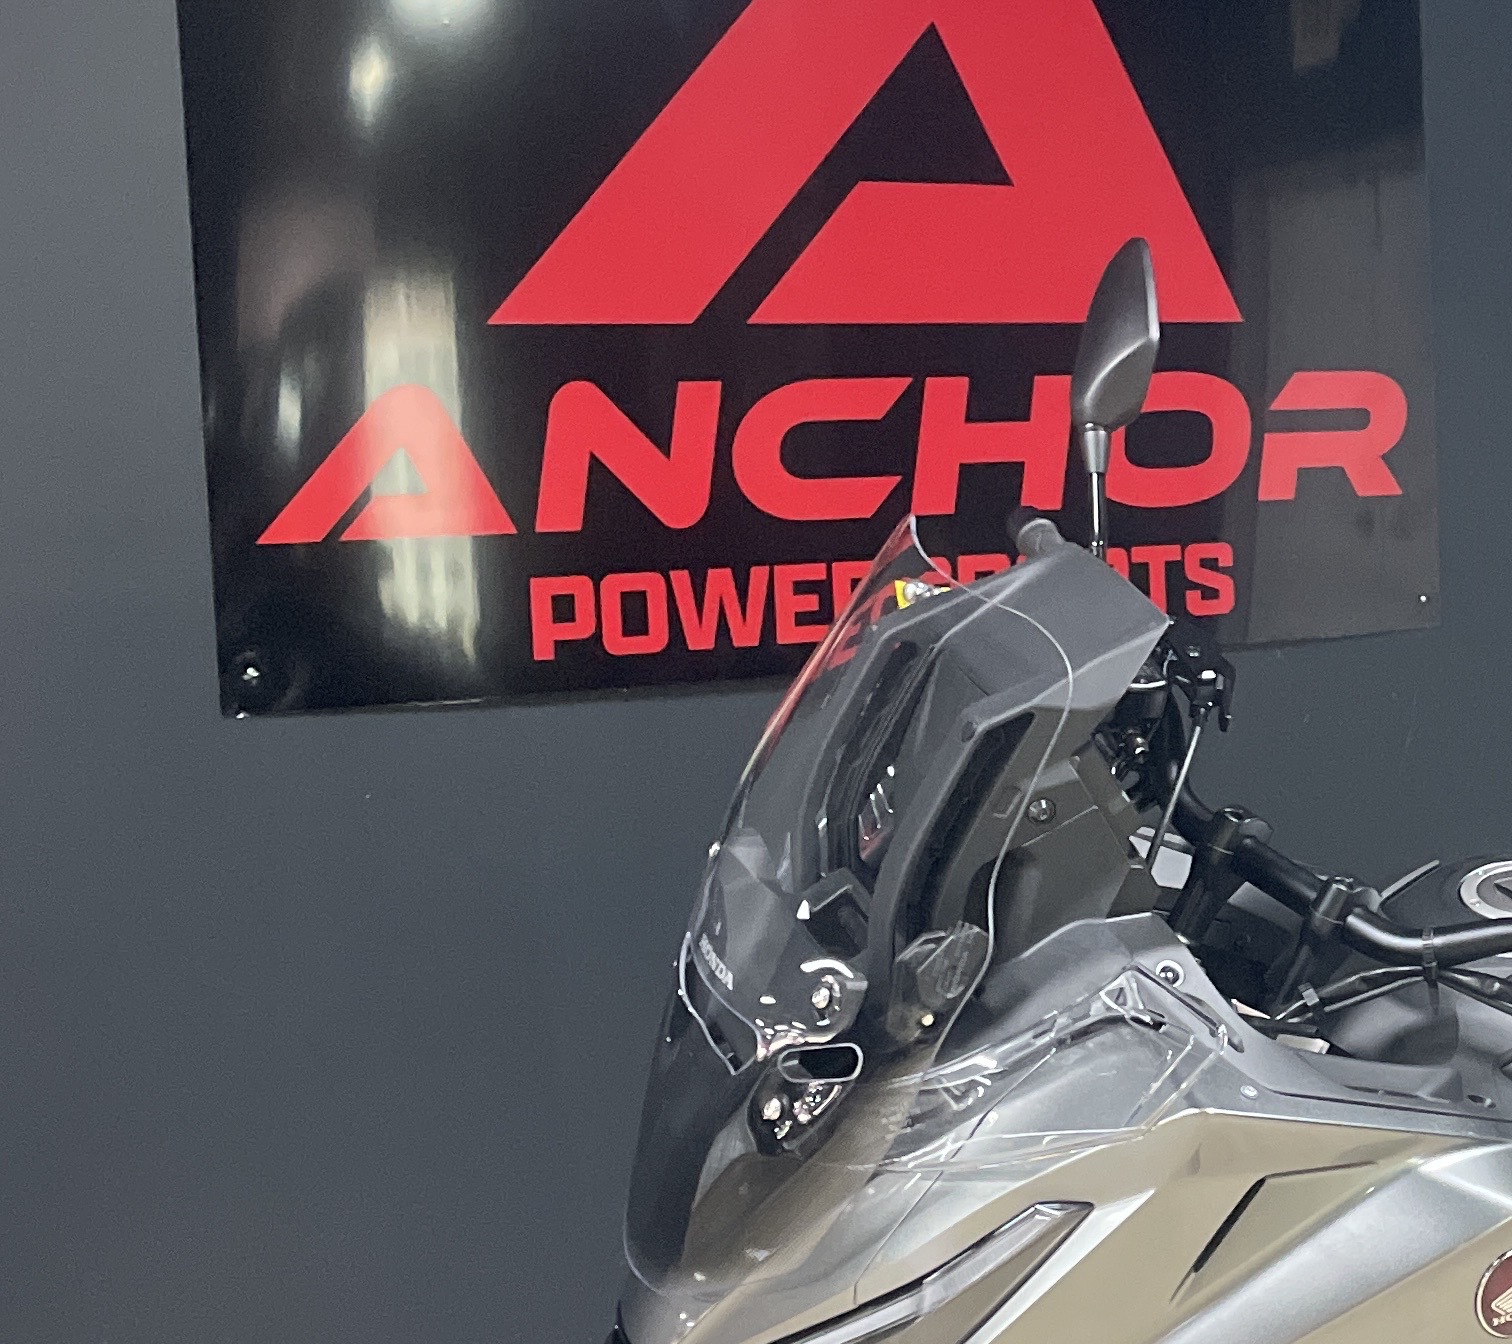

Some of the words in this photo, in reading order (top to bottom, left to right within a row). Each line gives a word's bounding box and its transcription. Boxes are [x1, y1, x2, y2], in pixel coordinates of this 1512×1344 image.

[256, 370, 1408, 544] ANCHOR
[529, 542, 1236, 661] POWETS
[699, 932, 733, 991] HONDA
